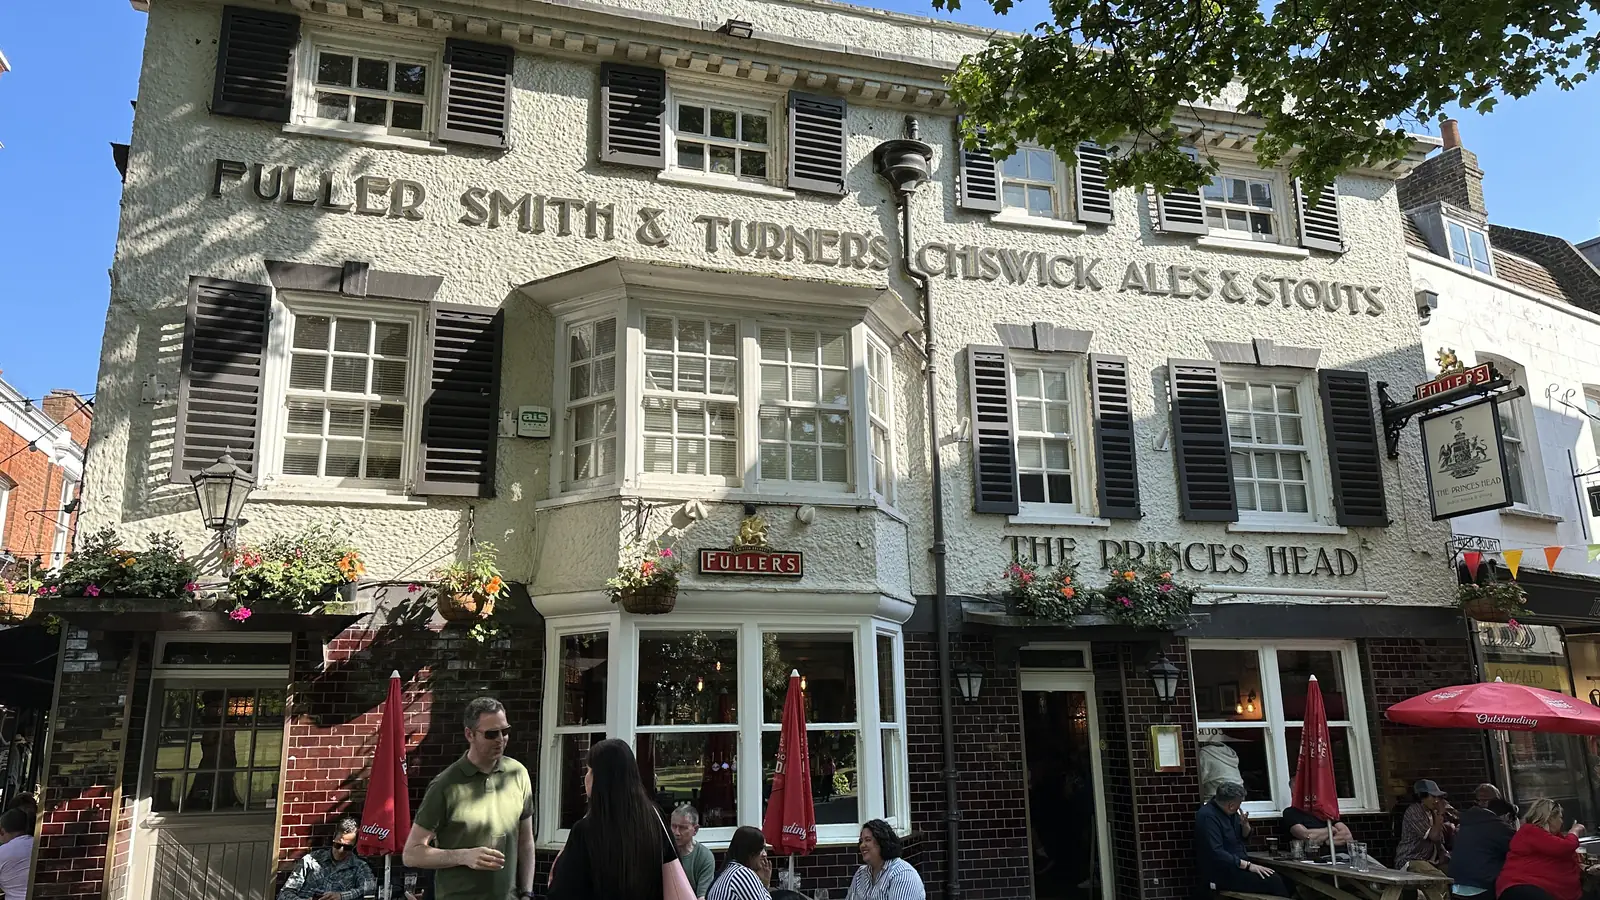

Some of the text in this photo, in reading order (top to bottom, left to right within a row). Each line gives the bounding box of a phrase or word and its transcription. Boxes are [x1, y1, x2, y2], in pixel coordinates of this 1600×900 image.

[212, 158, 427, 221] FULLER
[459, 186, 615, 241] SMITH
[636, 206, 670, 247] &
[916, 242, 1386, 316] CHISWICK ALES & STOUTS
[1436, 477, 1502, 497] THE PRINCES HEAD
[706, 552, 796, 573] FULLER'S
[1001, 535, 1360, 577] THE PRINCES HEAD
[1475, 713, 1538, 728] Outstanding
